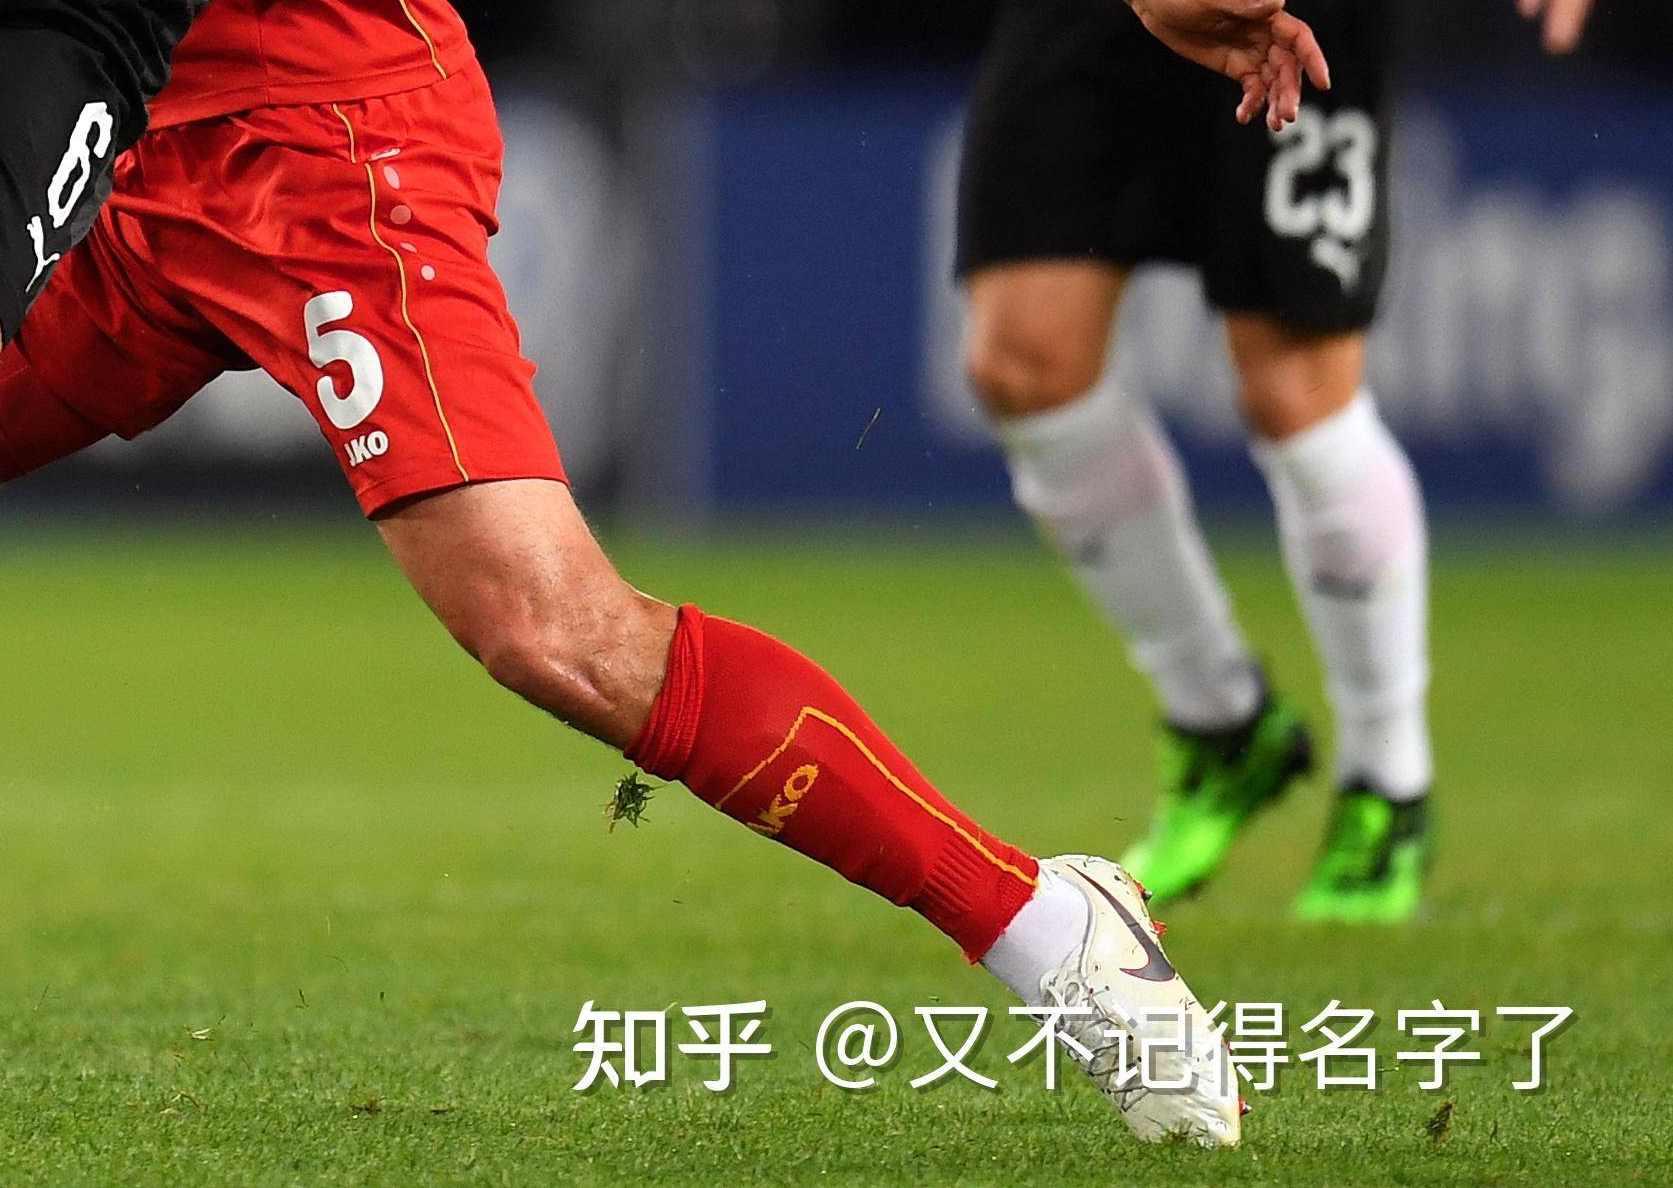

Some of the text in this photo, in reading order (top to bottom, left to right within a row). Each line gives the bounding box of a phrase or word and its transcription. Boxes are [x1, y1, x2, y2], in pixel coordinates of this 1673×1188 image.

[47, 101, 114, 229] 6
[1264, 105, 1376, 239] 23
[303, 290, 384, 429] 5
